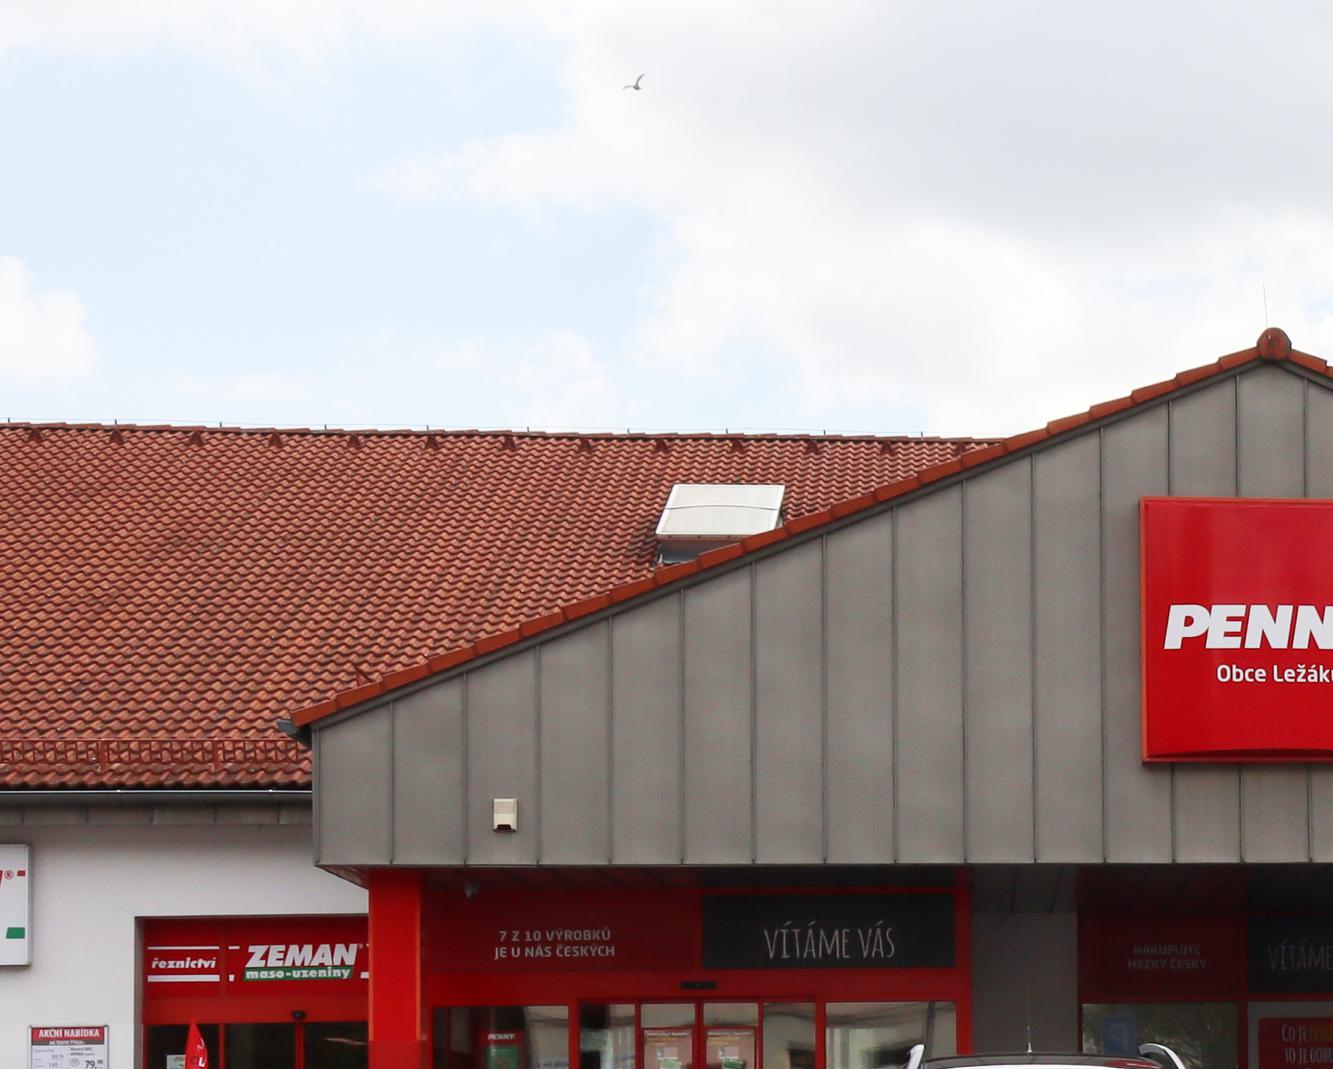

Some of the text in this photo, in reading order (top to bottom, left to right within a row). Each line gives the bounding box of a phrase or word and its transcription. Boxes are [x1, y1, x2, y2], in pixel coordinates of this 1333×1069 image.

[1216, 664, 1267, 683] Obce
[499, 926, 612, 942] 7 Z 10 VÝROBKŮ
[763, 920, 896, 959] VÍTÁME VÁS
[245, 943, 359, 968] ZEMAN
[494, 942, 616, 960] JE U NÁS ČESKÝCH
[1267, 938, 1333, 971] VÍTÁME
[151, 956, 217, 970] řeznictví
[245, 966, 351, 980] maso-uzeniny
[64, 1028, 100, 1038] NABÍDKA
